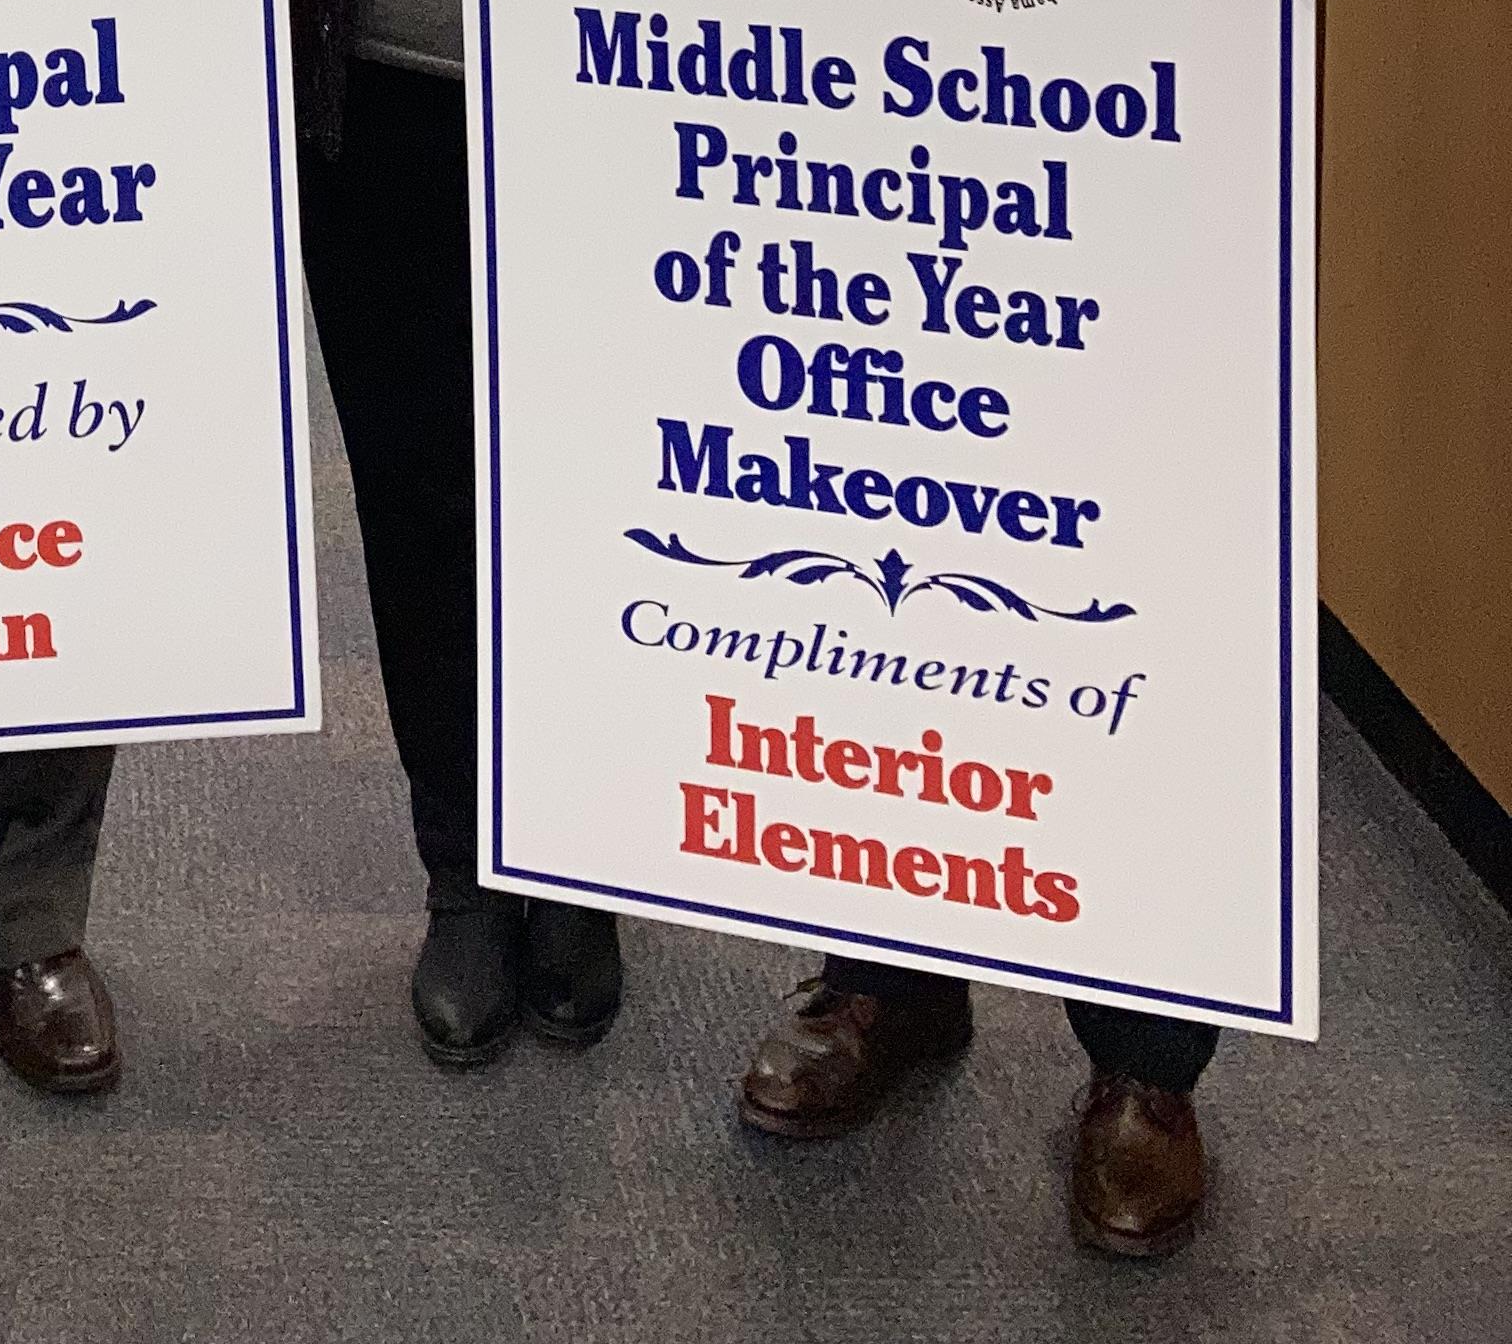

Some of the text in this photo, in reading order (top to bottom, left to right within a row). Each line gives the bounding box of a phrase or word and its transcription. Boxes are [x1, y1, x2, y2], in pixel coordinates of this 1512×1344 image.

[574, 8, 1181, 142] Middle School
[674, 122, 1072, 251] Principal
[654, 231, 1100, 350] of the Year
[68, 379, 145, 451] by
[737, 334, 1010, 437] Office
[657, 418, 1100, 548] Makeover
[621, 600, 1146, 734] Compliments of
[705, 695, 1053, 820] Interior
[679, 782, 1080, 923] Elements
